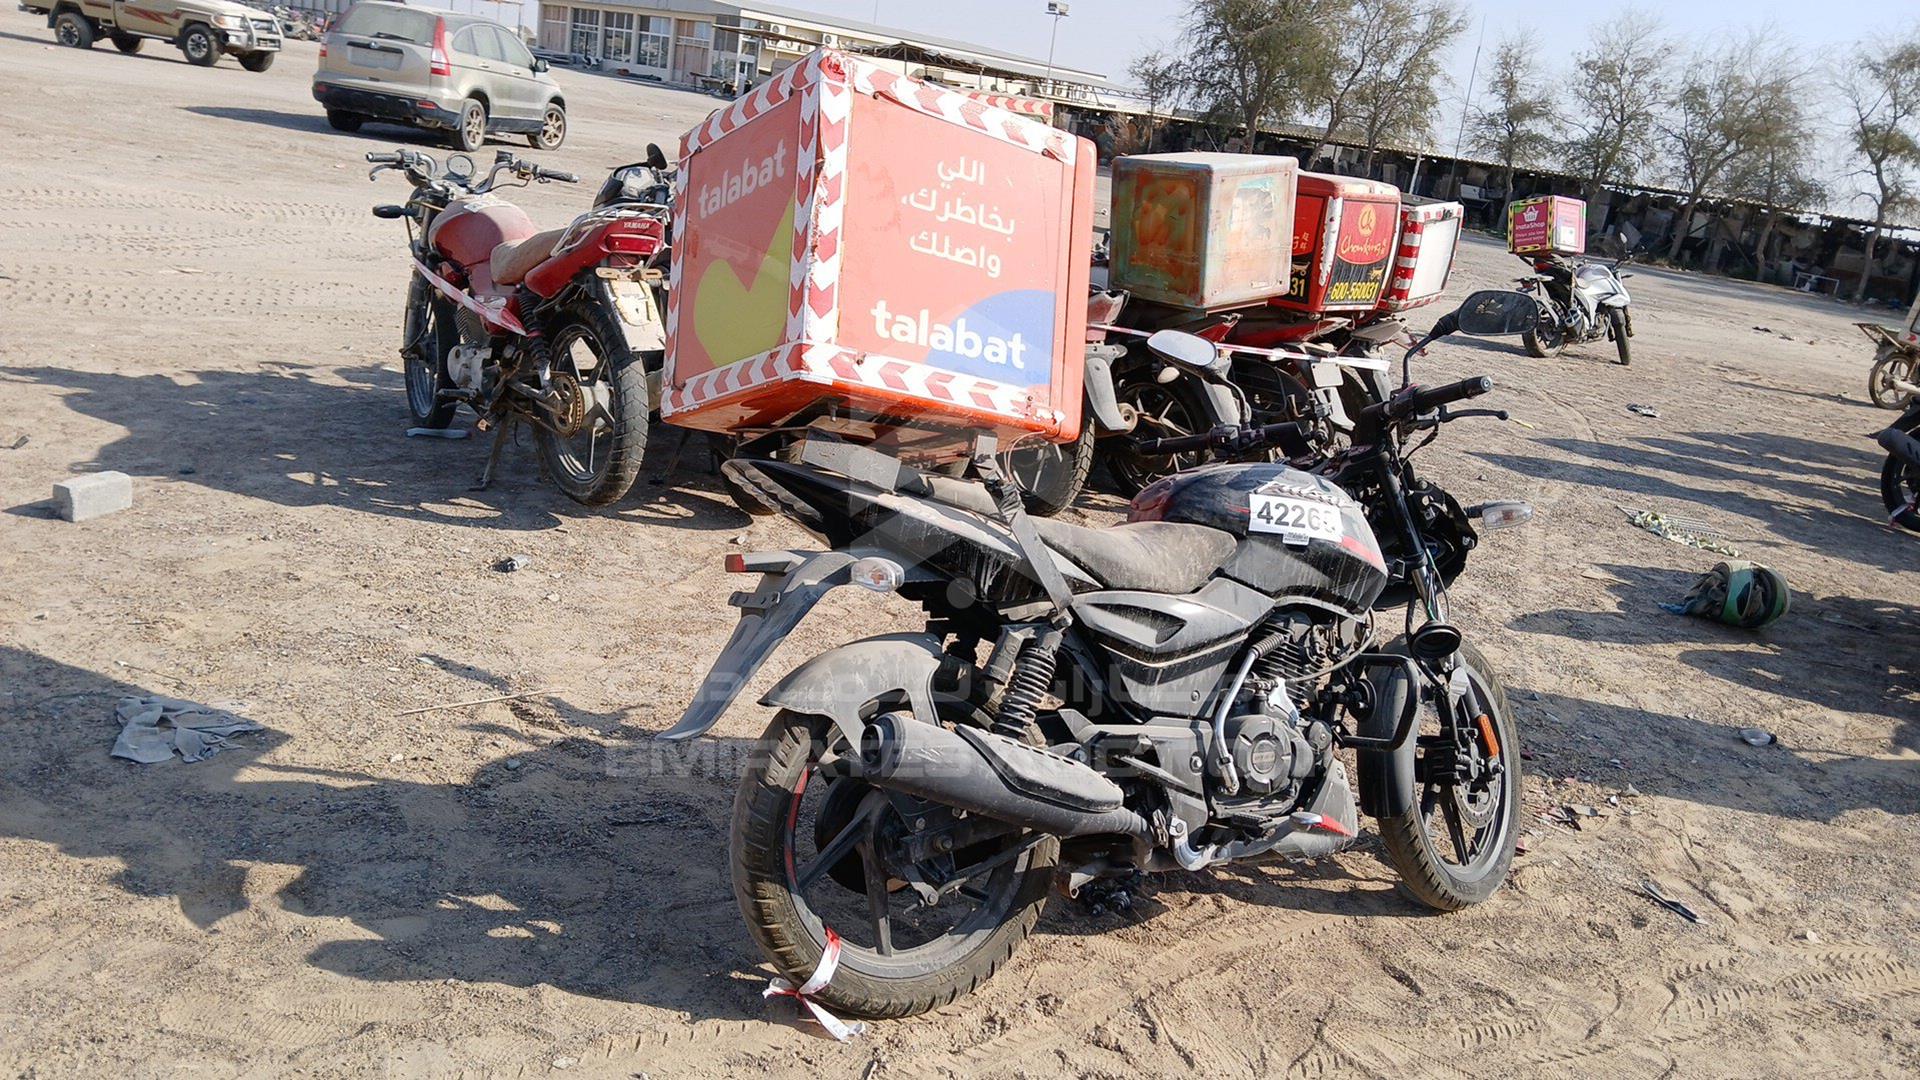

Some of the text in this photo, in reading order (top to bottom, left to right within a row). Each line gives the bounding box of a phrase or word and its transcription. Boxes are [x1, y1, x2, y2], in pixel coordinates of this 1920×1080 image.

[699, 139, 787, 218] talabat
[936, 156, 985, 189] اللي
[623, 221, 650, 229] YAMAHA
[1330, 281, 1380, 300] 600-560031
[870, 300, 1026, 369] talabat
